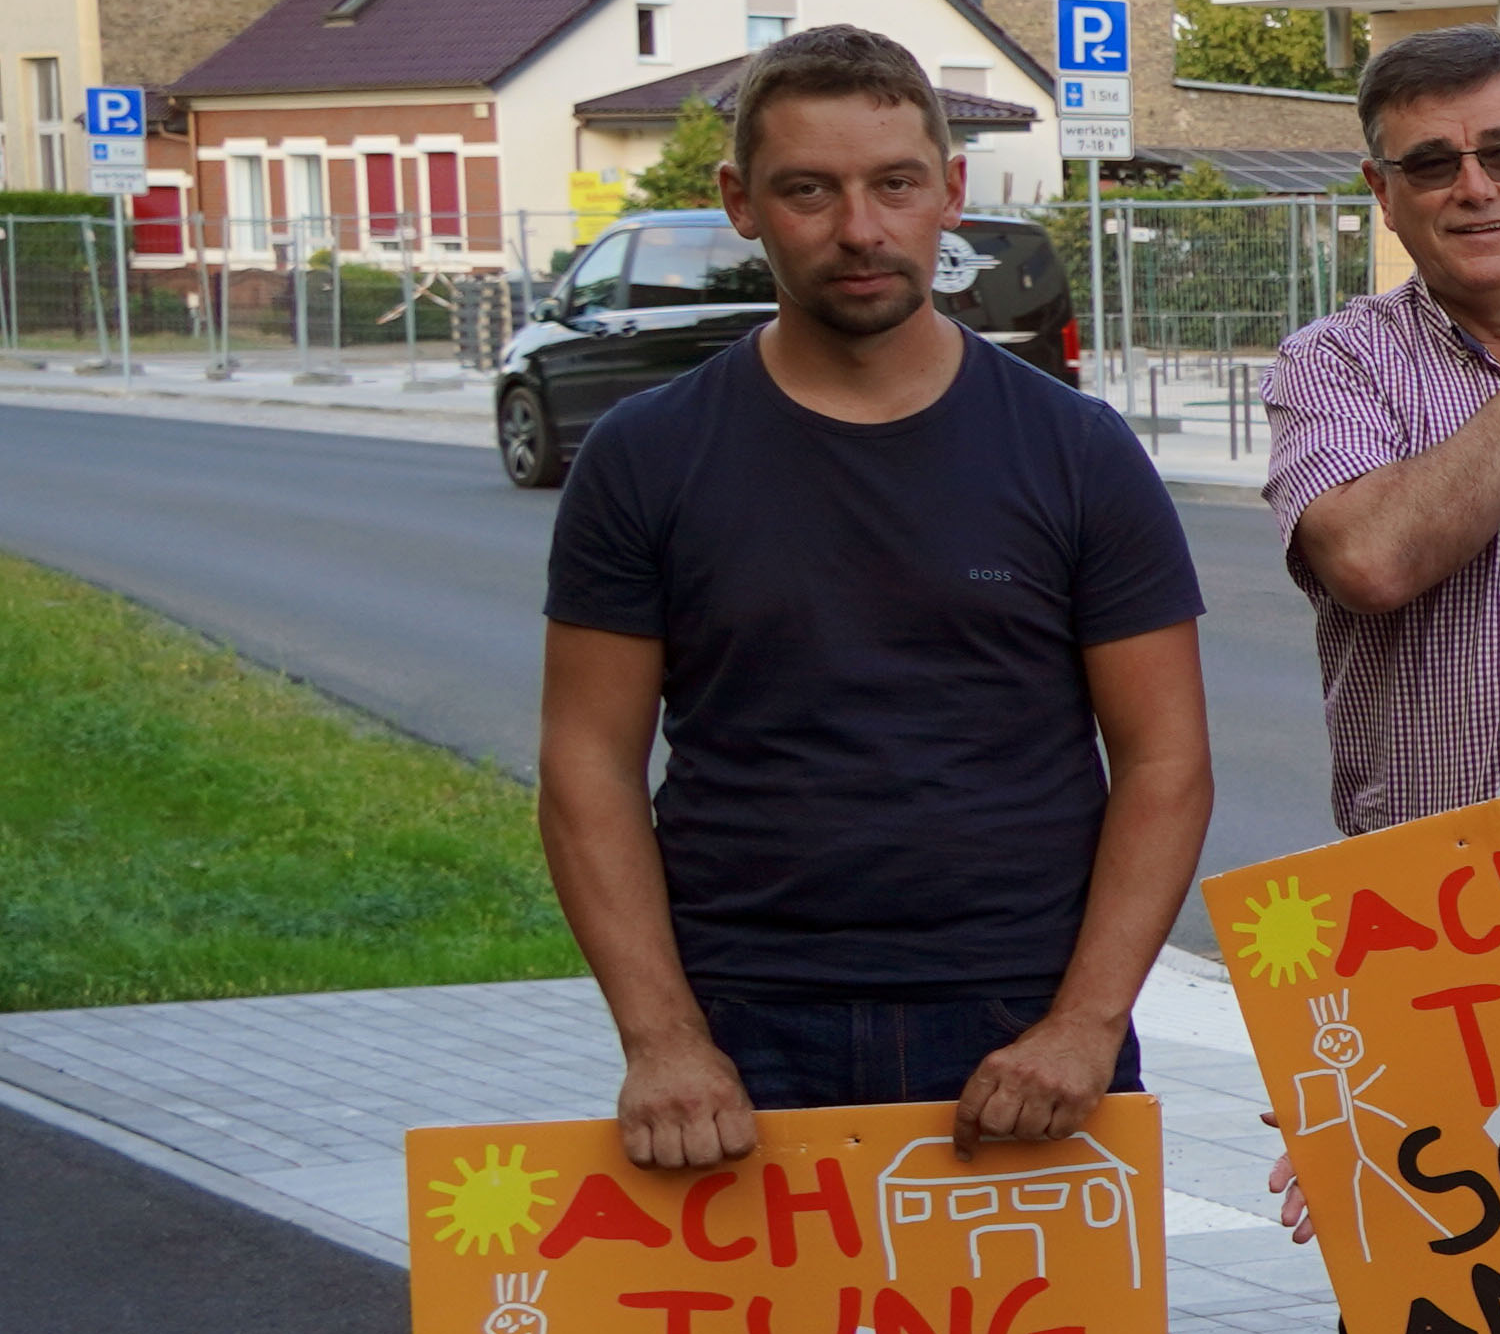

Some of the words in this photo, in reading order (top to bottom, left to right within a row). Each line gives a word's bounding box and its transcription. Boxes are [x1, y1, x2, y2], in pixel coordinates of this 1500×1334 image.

[1073, 6, 1112, 63] P
[97, 92, 131, 132] P
[969, 569, 1012, 581] BOSS
[539, 1157, 862, 1266] ACH
